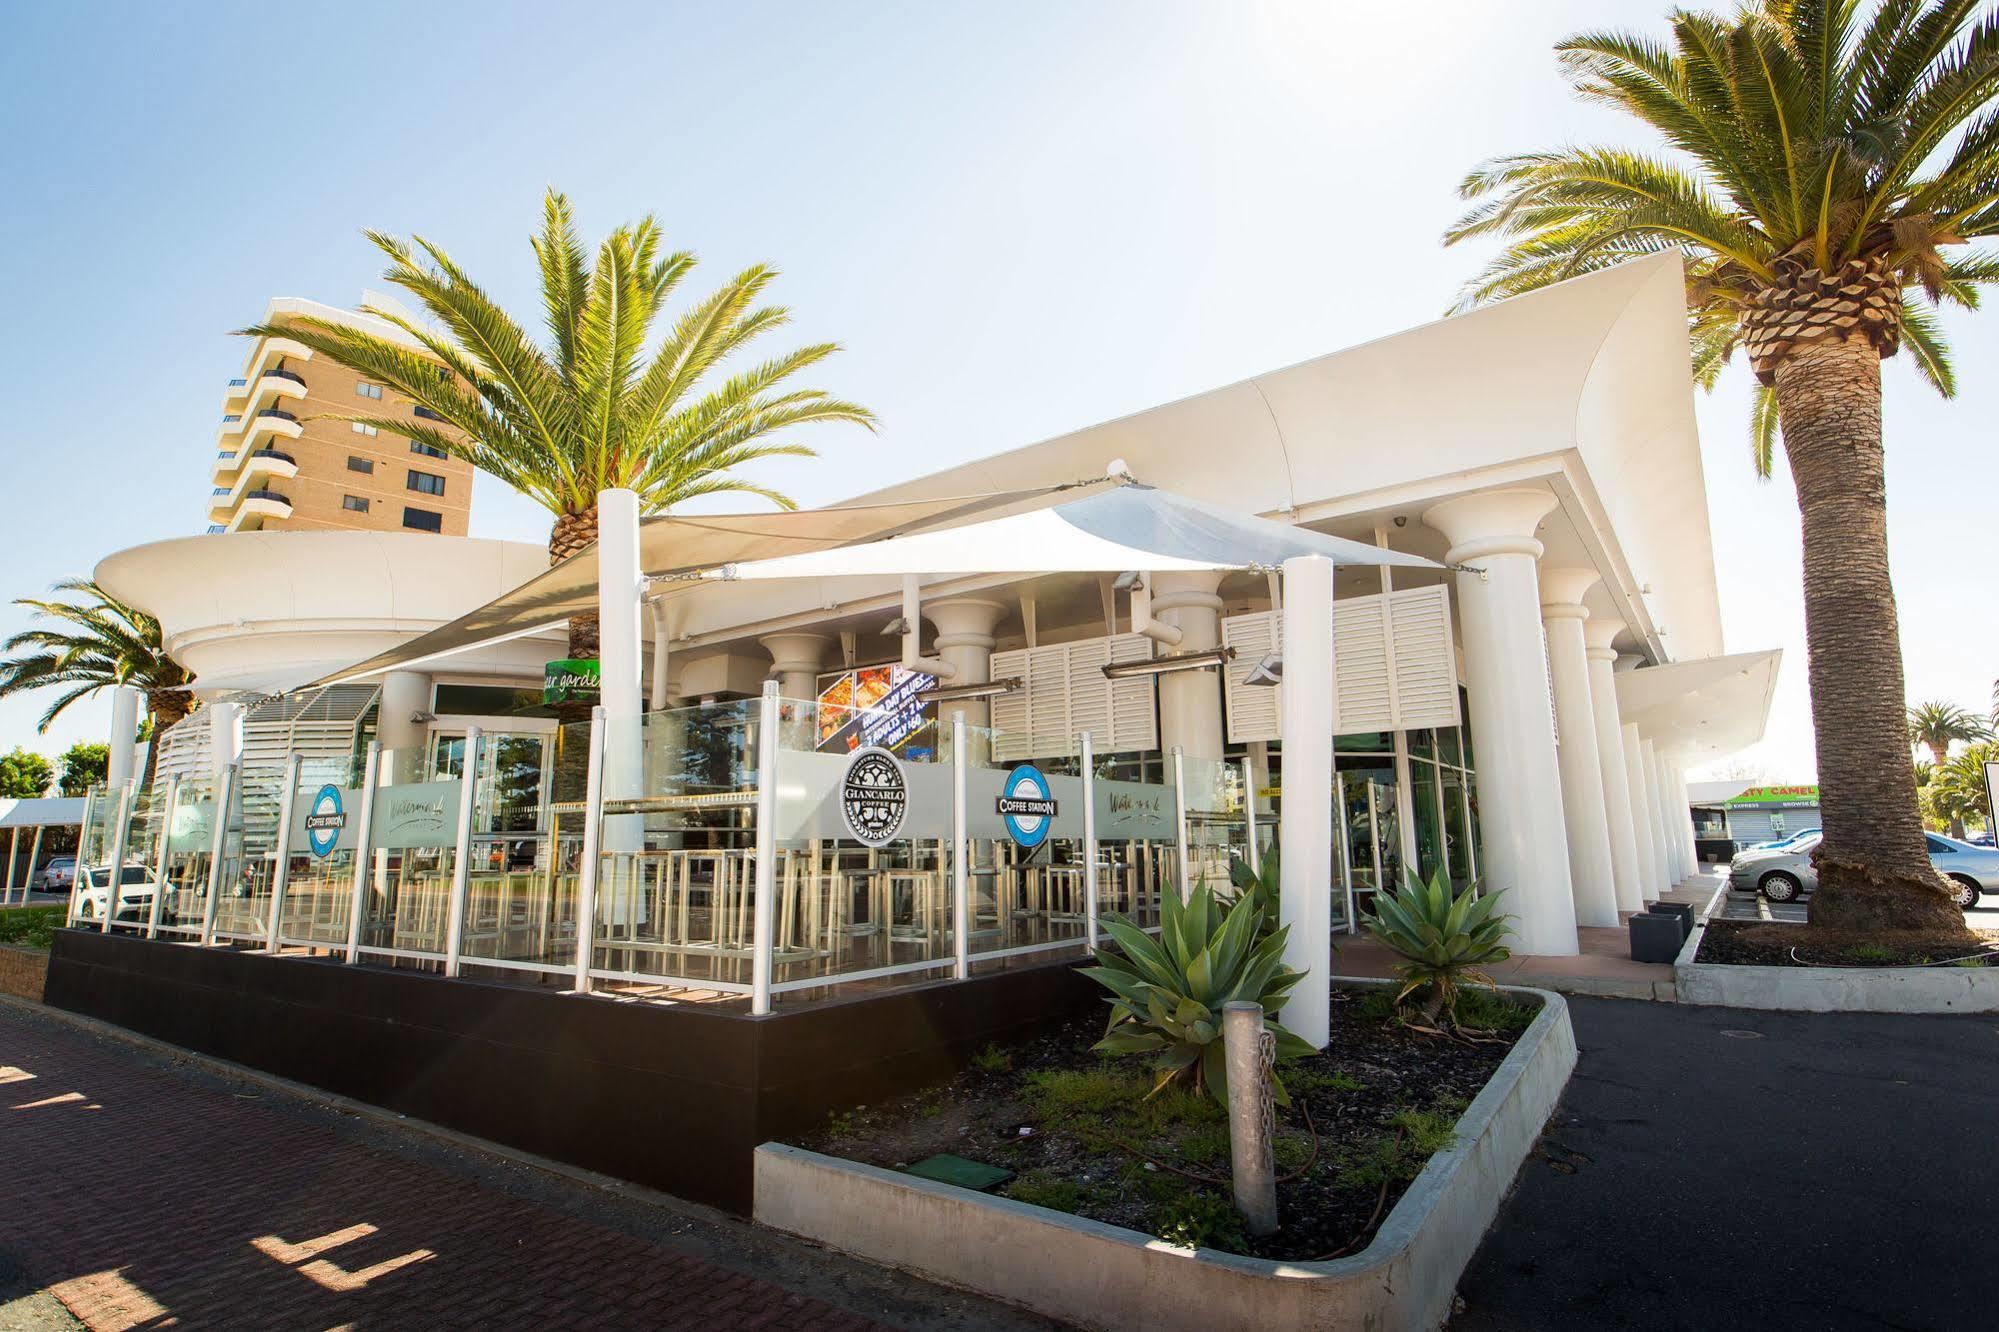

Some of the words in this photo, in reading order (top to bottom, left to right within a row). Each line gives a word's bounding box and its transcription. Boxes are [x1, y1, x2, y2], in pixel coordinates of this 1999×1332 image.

[560, 669, 600, 692] garde
[885, 692, 901, 711] DAY
[873, 714, 900, 744] ADULTS
[909, 702, 916, 716] 2
[888, 722, 907, 746] ONLY
[845, 788, 905, 801] GIANCARLO
[1770, 786, 1816, 796] CAMEL
[999, 798, 1027, 813] COFFEE
[1027, 802, 1055, 815] STATION
